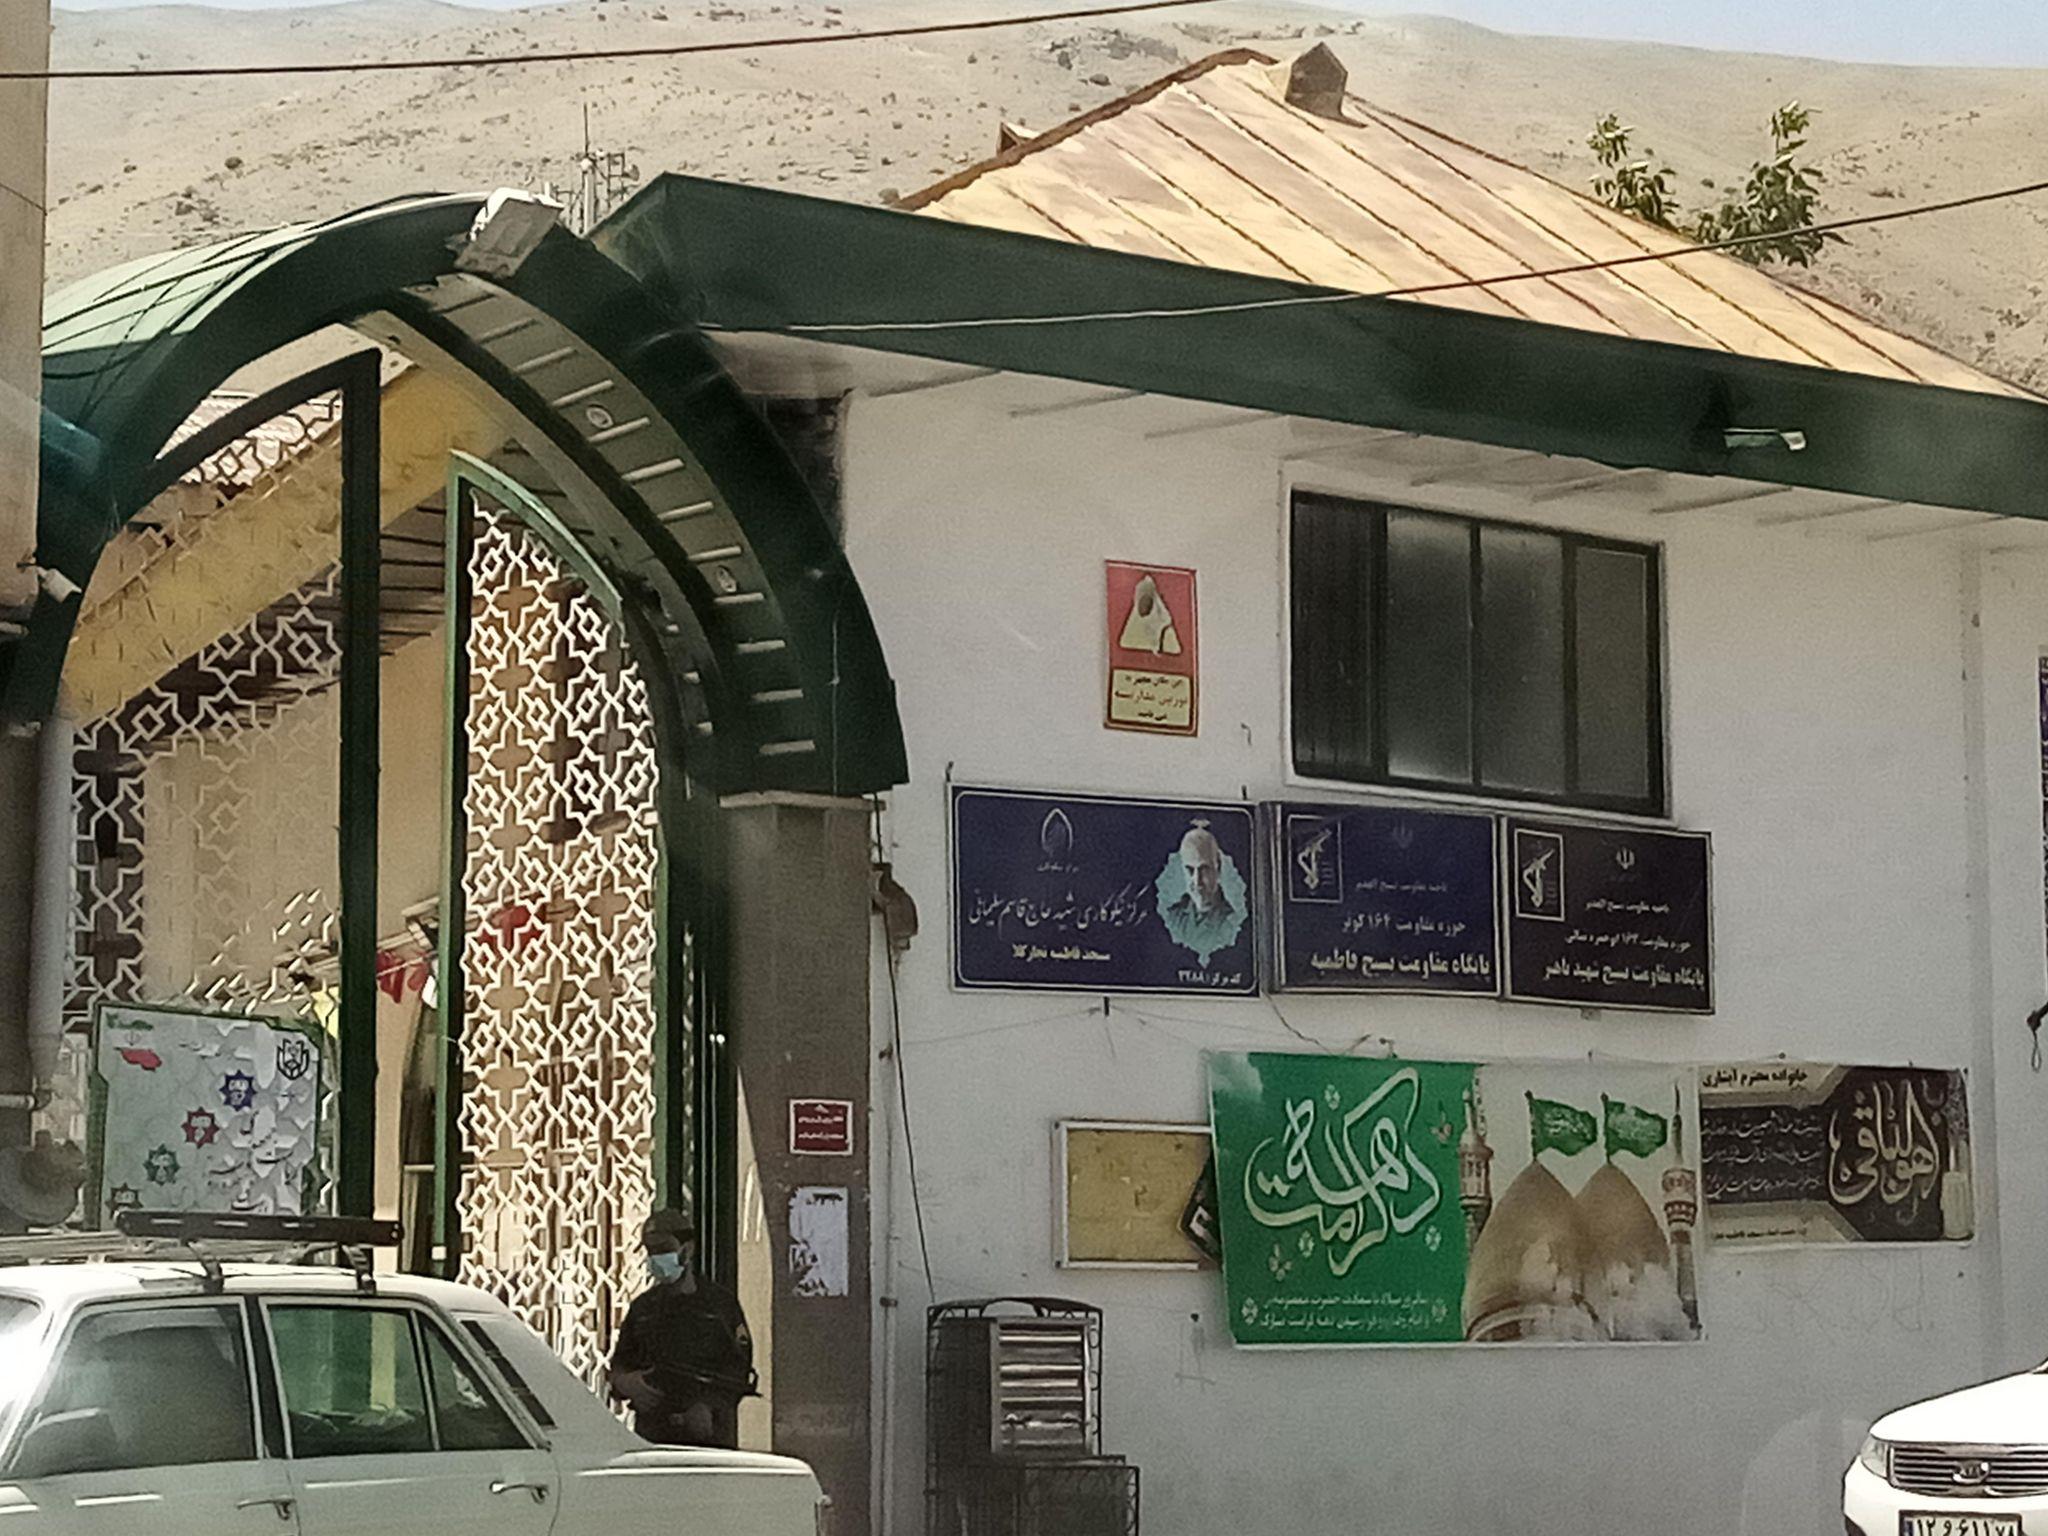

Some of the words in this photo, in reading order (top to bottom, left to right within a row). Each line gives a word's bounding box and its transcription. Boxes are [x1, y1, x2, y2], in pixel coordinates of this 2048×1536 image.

[968, 887, 1005, 927] سلیمانی
[1025, 900, 1051, 927] حاج
[1052, 890, 1077, 931] شهید
[1077, 882, 1131, 930] نیکوکاری
[1128, 882, 1150, 926] مرکز
[998, 897, 1029, 940] قاسم
[1395, 916, 1435, 936] مقاومت
[1438, 920, 1466, 937] حوزه
[1081, 947, 1112, 963] مسجد
[1311, 946, 1358, 976] فاطمیه
[1360, 955, 1396, 978] بسیج
[1399, 950, 1449, 979] مقاومت
[1452, 952, 1491, 983] پایگاه
[1572, 959, 1600, 983] شهید
[1601, 964, 1630, 985] بسیج
[1631, 963, 1673, 988] مقاومت
[1674, 966, 1705, 991] پایگاه
[1740, 1070, 1769, 1087] محترم
[1772, 1068, 1808, 1087] خانواده
